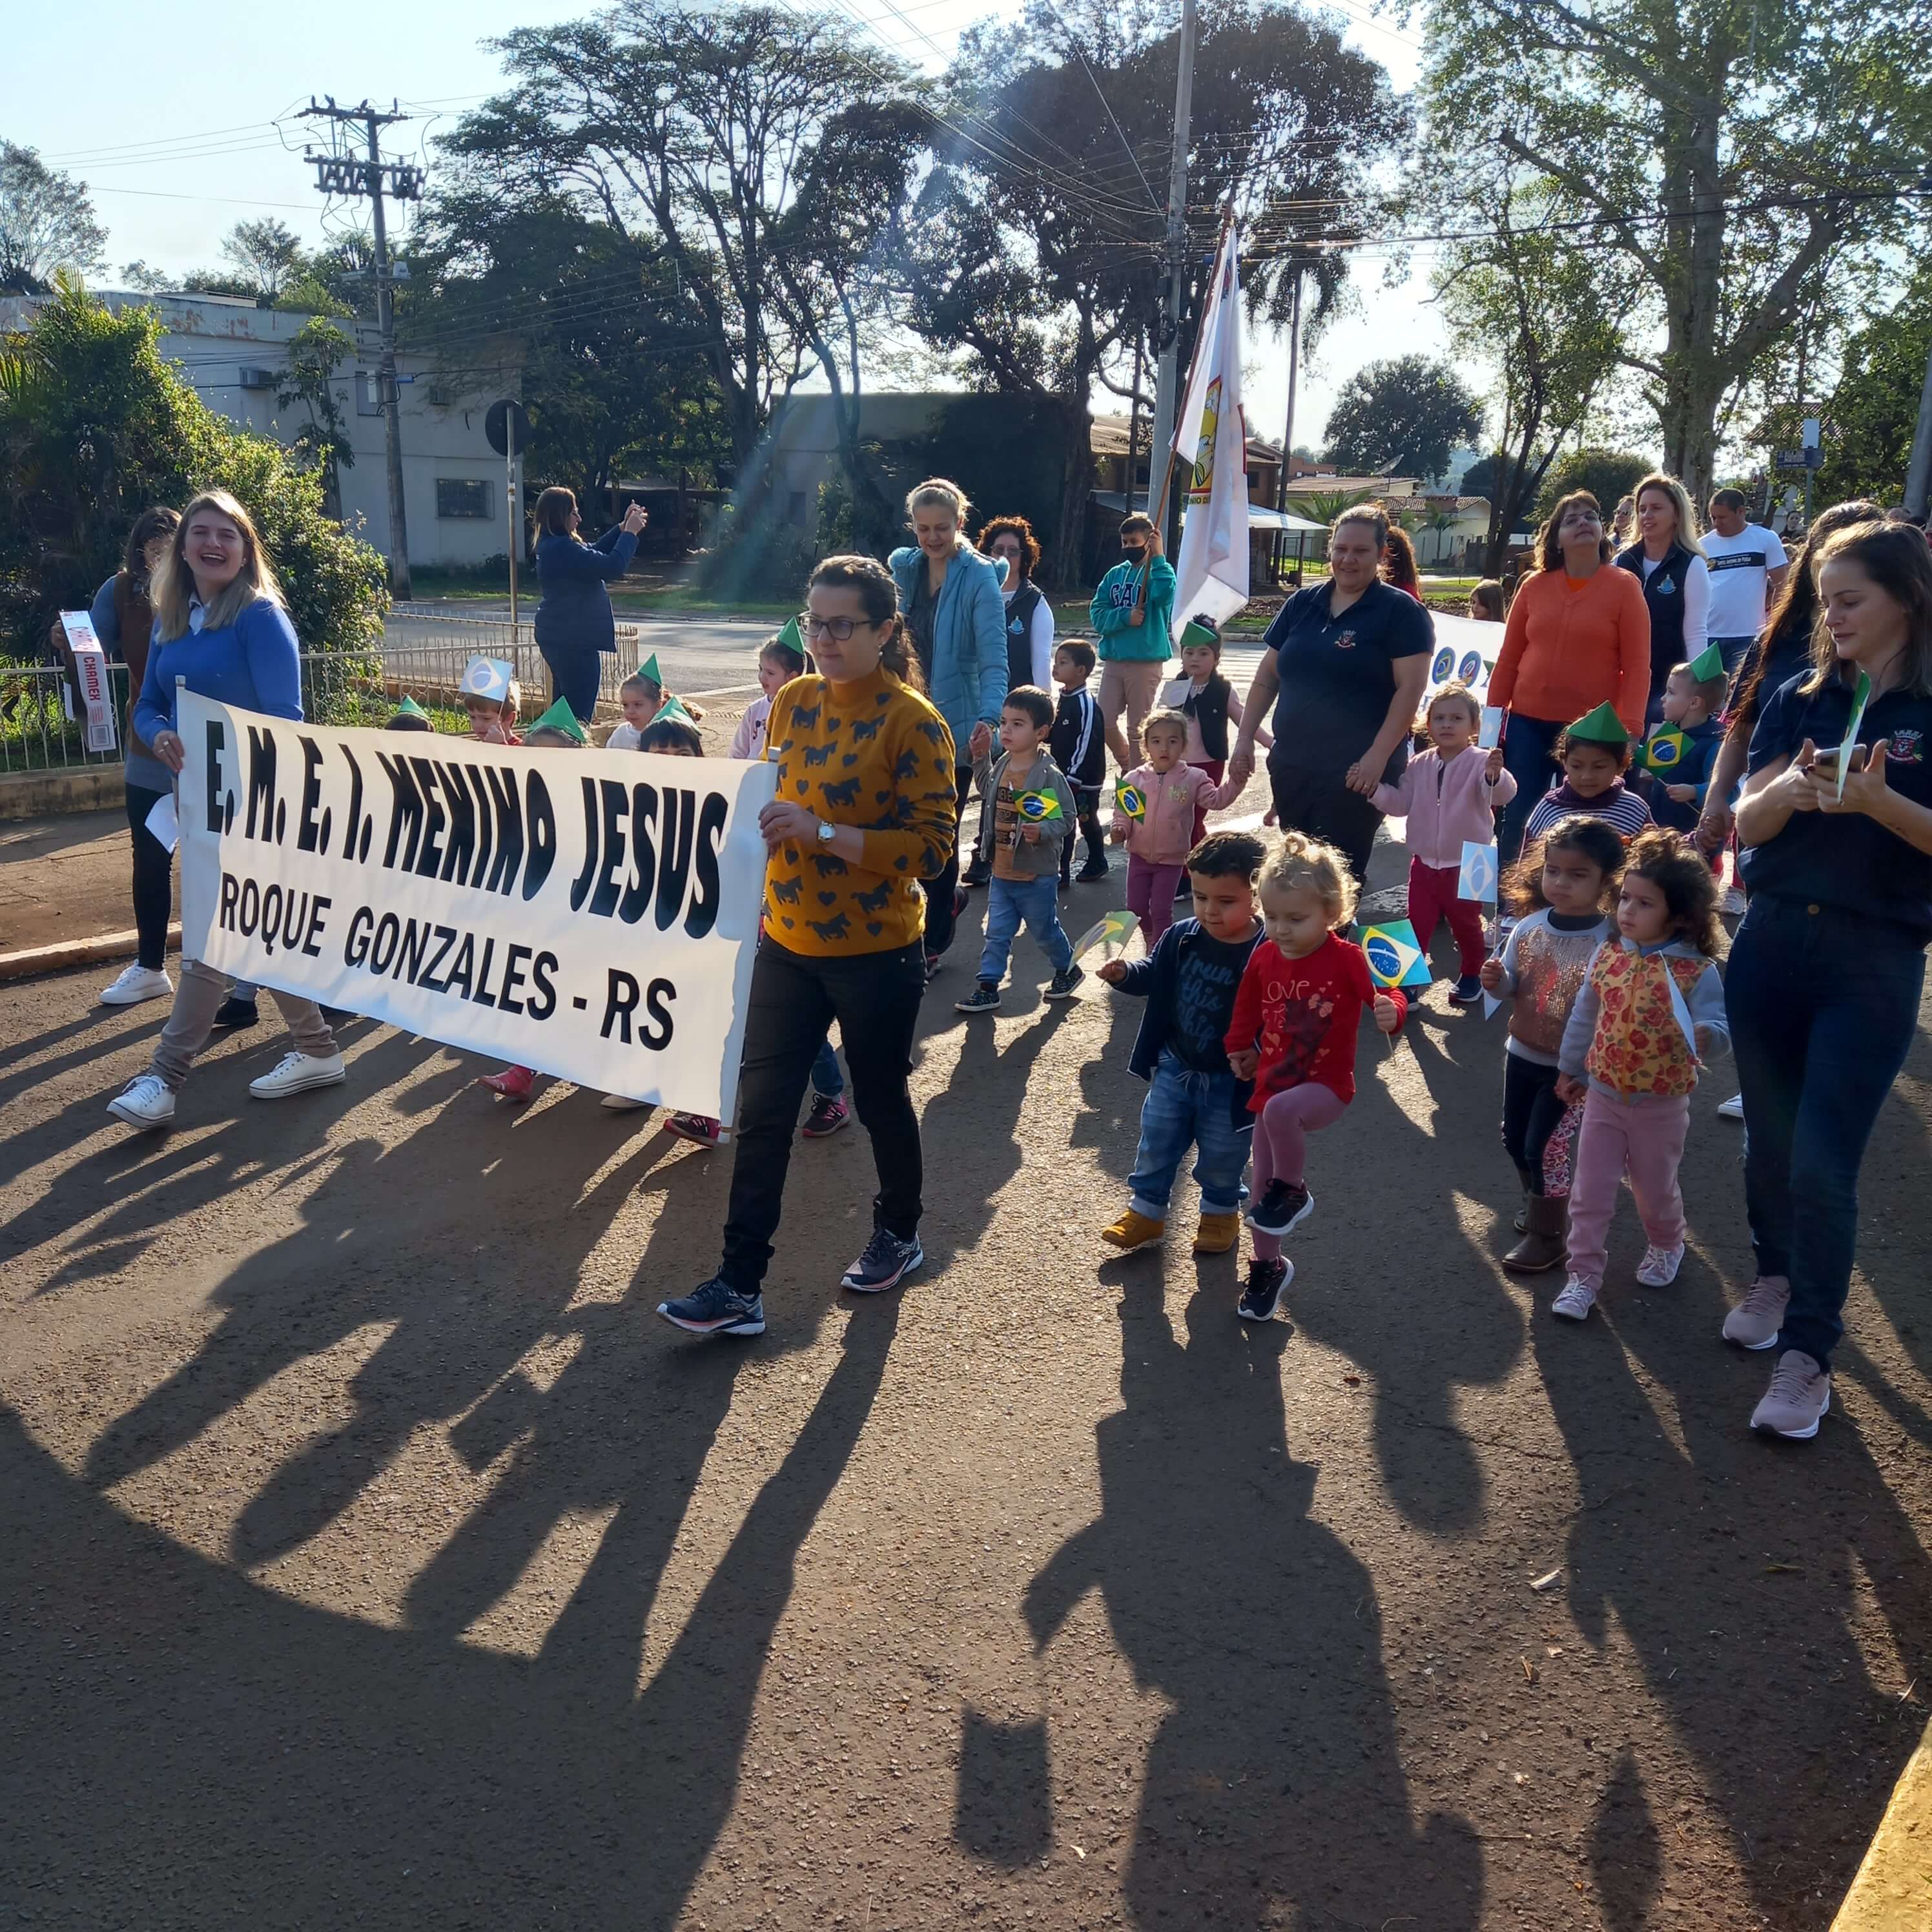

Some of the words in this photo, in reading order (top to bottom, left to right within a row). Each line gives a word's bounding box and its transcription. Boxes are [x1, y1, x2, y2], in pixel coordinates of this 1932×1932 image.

[83, 656, 101, 701] CHAMEX
[375, 750, 557, 902] MENINO
[570, 776, 729, 940] JESUS
[219, 871, 333, 957] ROQUE
[344, 905, 559, 1021] GONZALES
[599, 967, 677, 1051] RS
